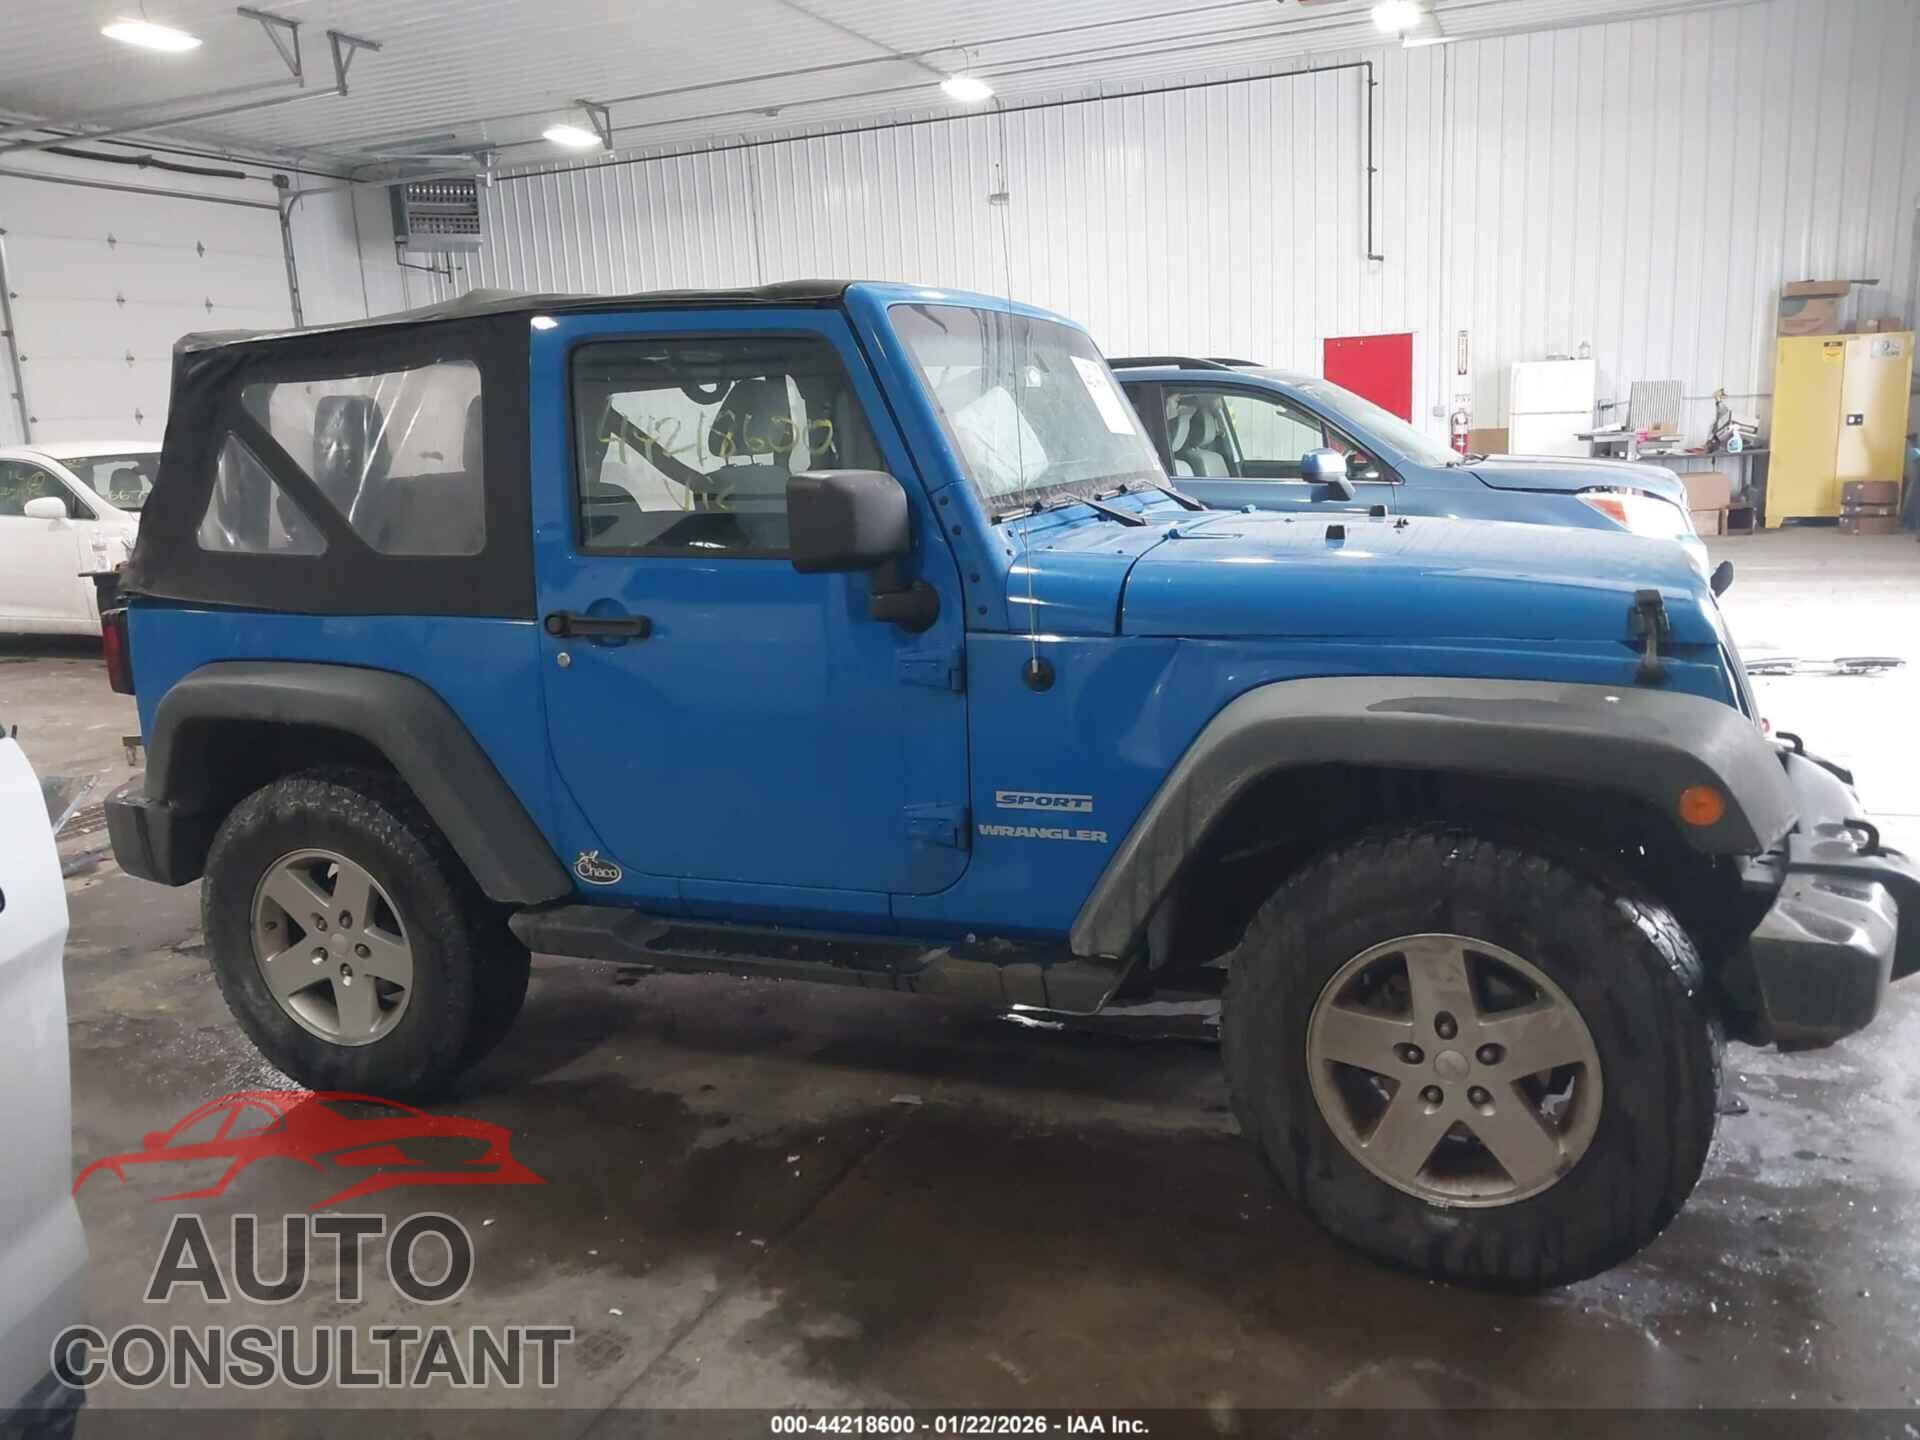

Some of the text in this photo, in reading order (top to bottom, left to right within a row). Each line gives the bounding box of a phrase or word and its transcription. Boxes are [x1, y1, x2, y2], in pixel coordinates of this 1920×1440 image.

[998, 792, 1092, 811] SPORT
[979, 824, 1108, 843] WRANGLER
[577, 861, 618, 878] Chaco
